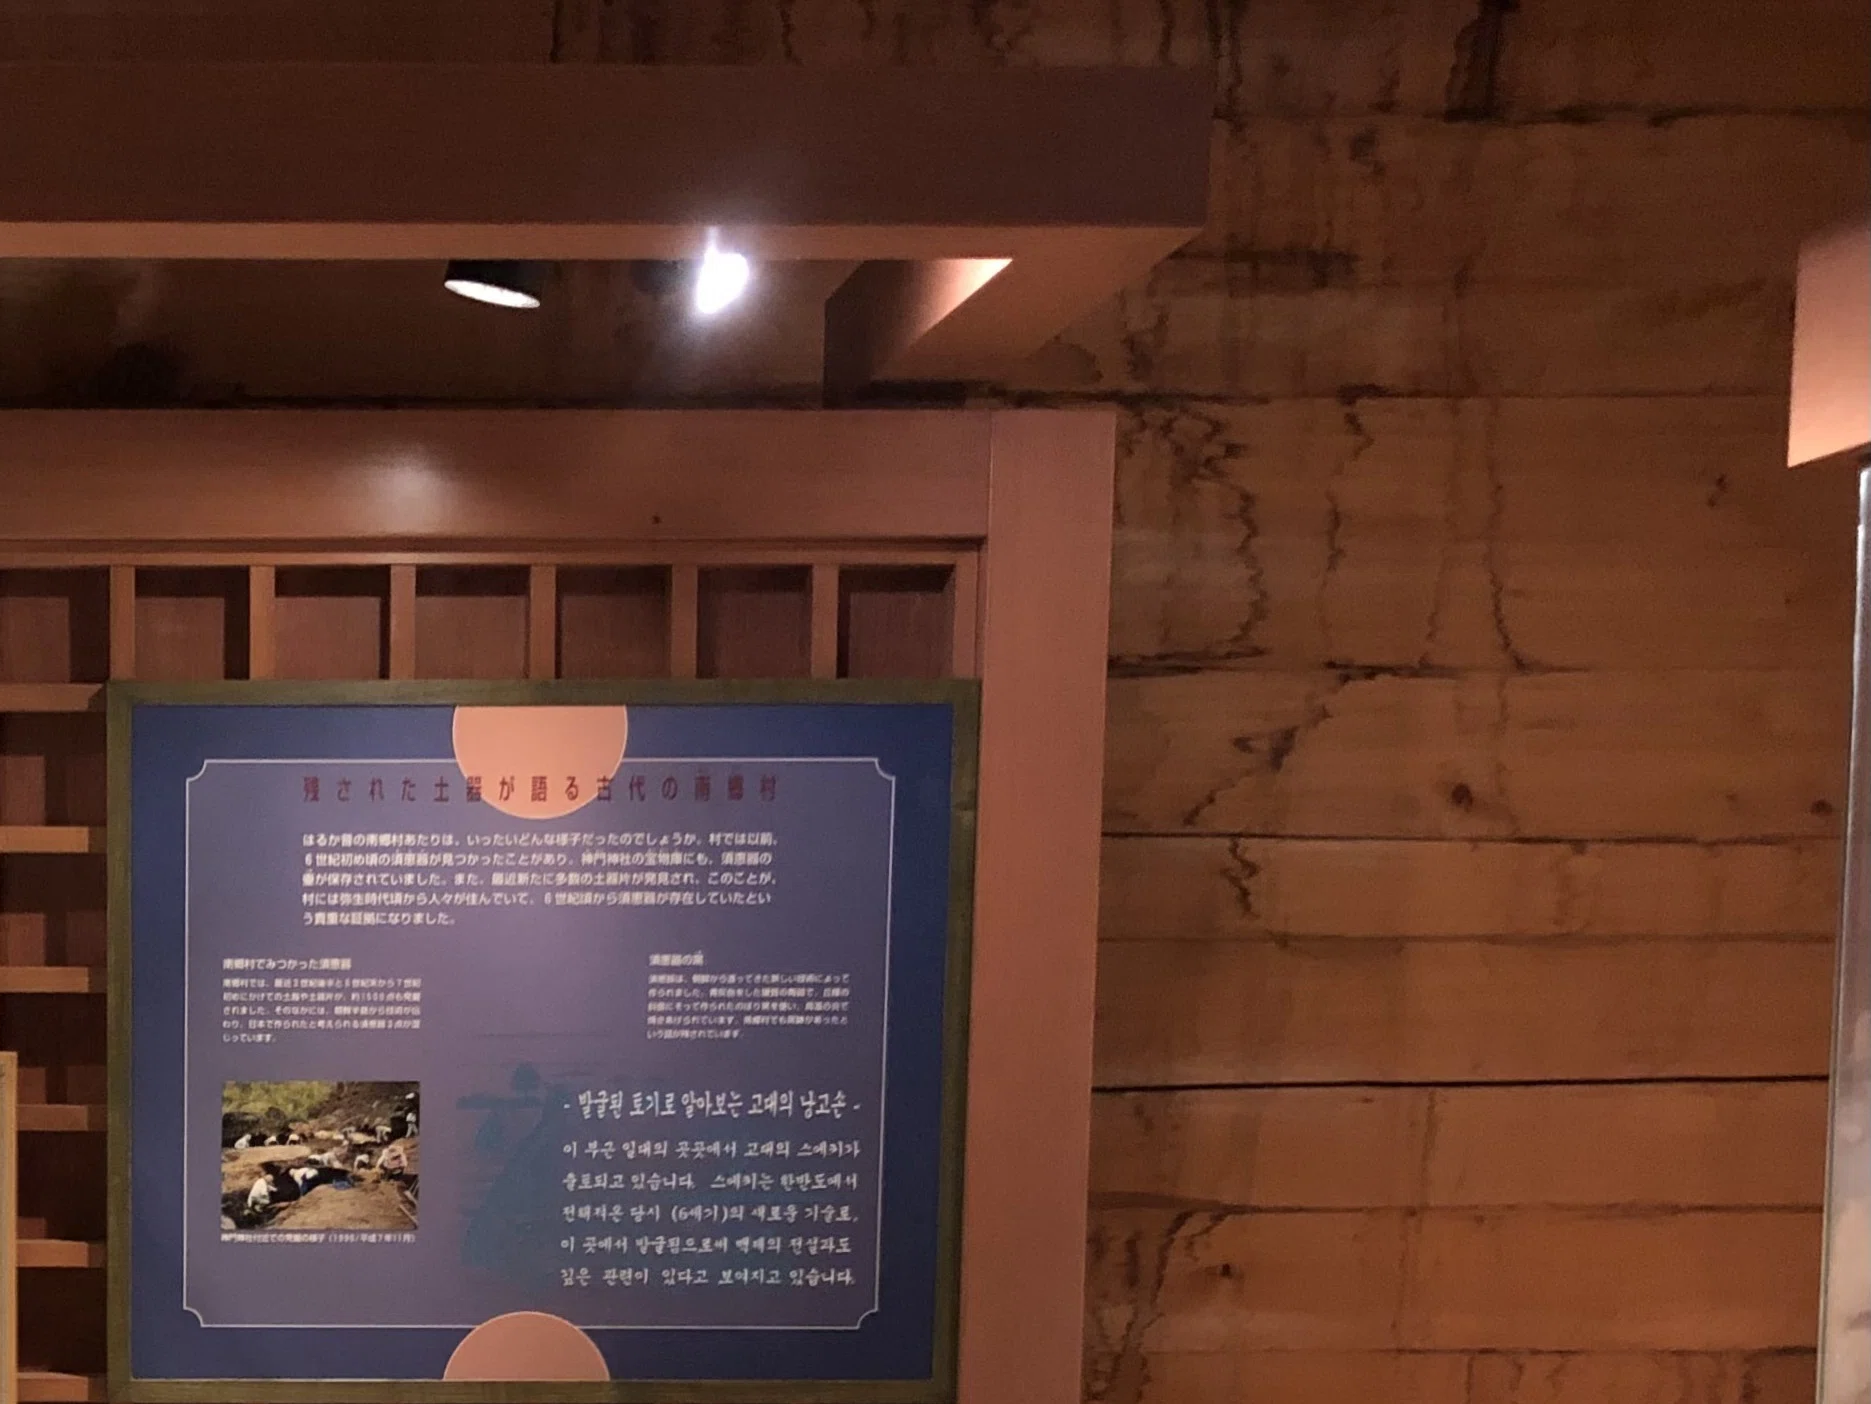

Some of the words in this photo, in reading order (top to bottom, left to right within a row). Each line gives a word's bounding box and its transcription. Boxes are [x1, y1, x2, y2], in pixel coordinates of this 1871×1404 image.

[578, 1090, 624, 1120] 발굴된
[629, 1091, 677, 1117] 토기로
[681, 1089, 743, 1119] 알아보는
[747, 1089, 794, 1118] 고대의
[563, 1141, 578, 1160] 이
[584, 1140, 617, 1160] 부근
[622, 1140, 669, 1160] 일대의
[743, 1140, 790, 1160] 고대의
[630, 1204, 661, 1223] 당시
[560, 1236, 575, 1254] 이
[582, 1236, 628, 1254] 곳에서
